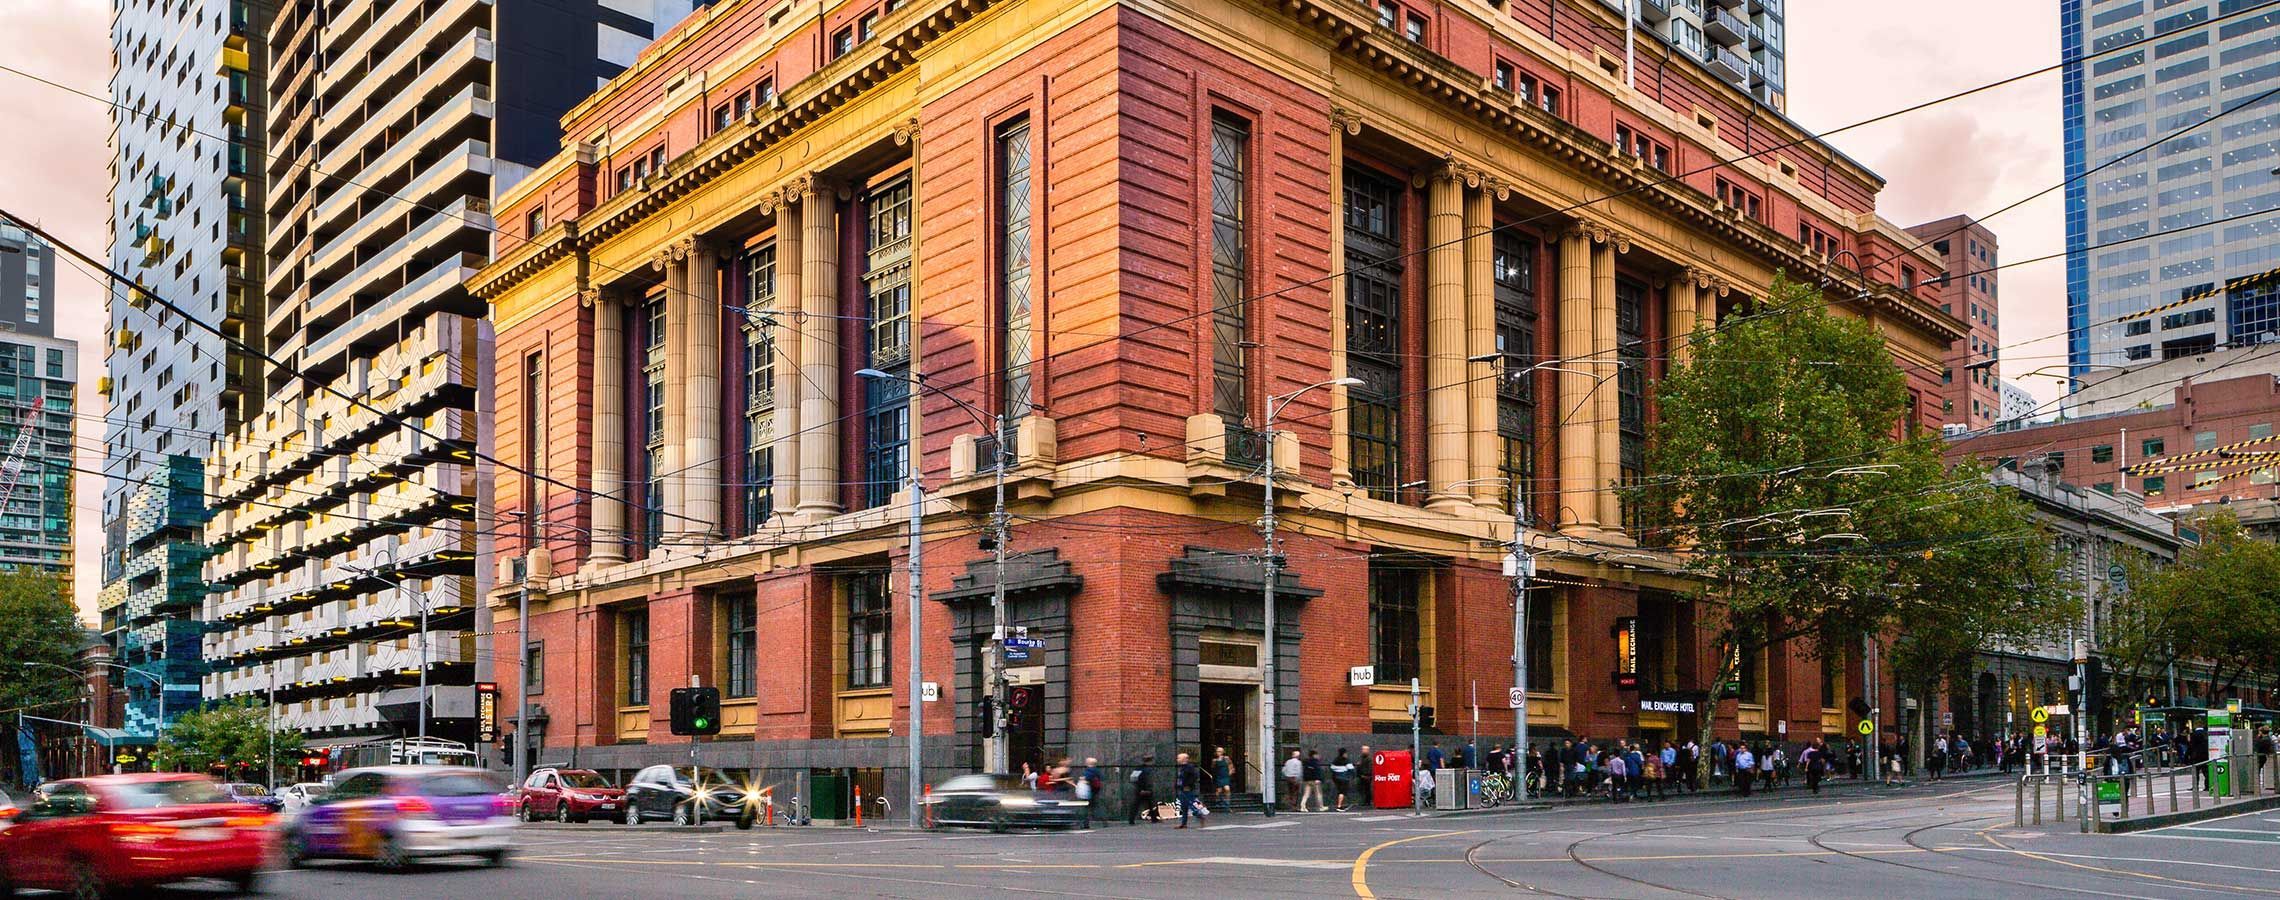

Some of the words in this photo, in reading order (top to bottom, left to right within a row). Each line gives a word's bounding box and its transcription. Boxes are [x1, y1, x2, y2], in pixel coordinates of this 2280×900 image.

[1353, 669, 1372, 680] hub
[922, 684, 935, 697] ub
[1511, 693, 1522, 702] 40
[485, 693, 493, 732] BISTRO
[1641, 700, 1653, 710] MAIL
[1654, 701, 1679, 712] EXCHANGE
[1679, 703, 1695, 713] HOTEL
